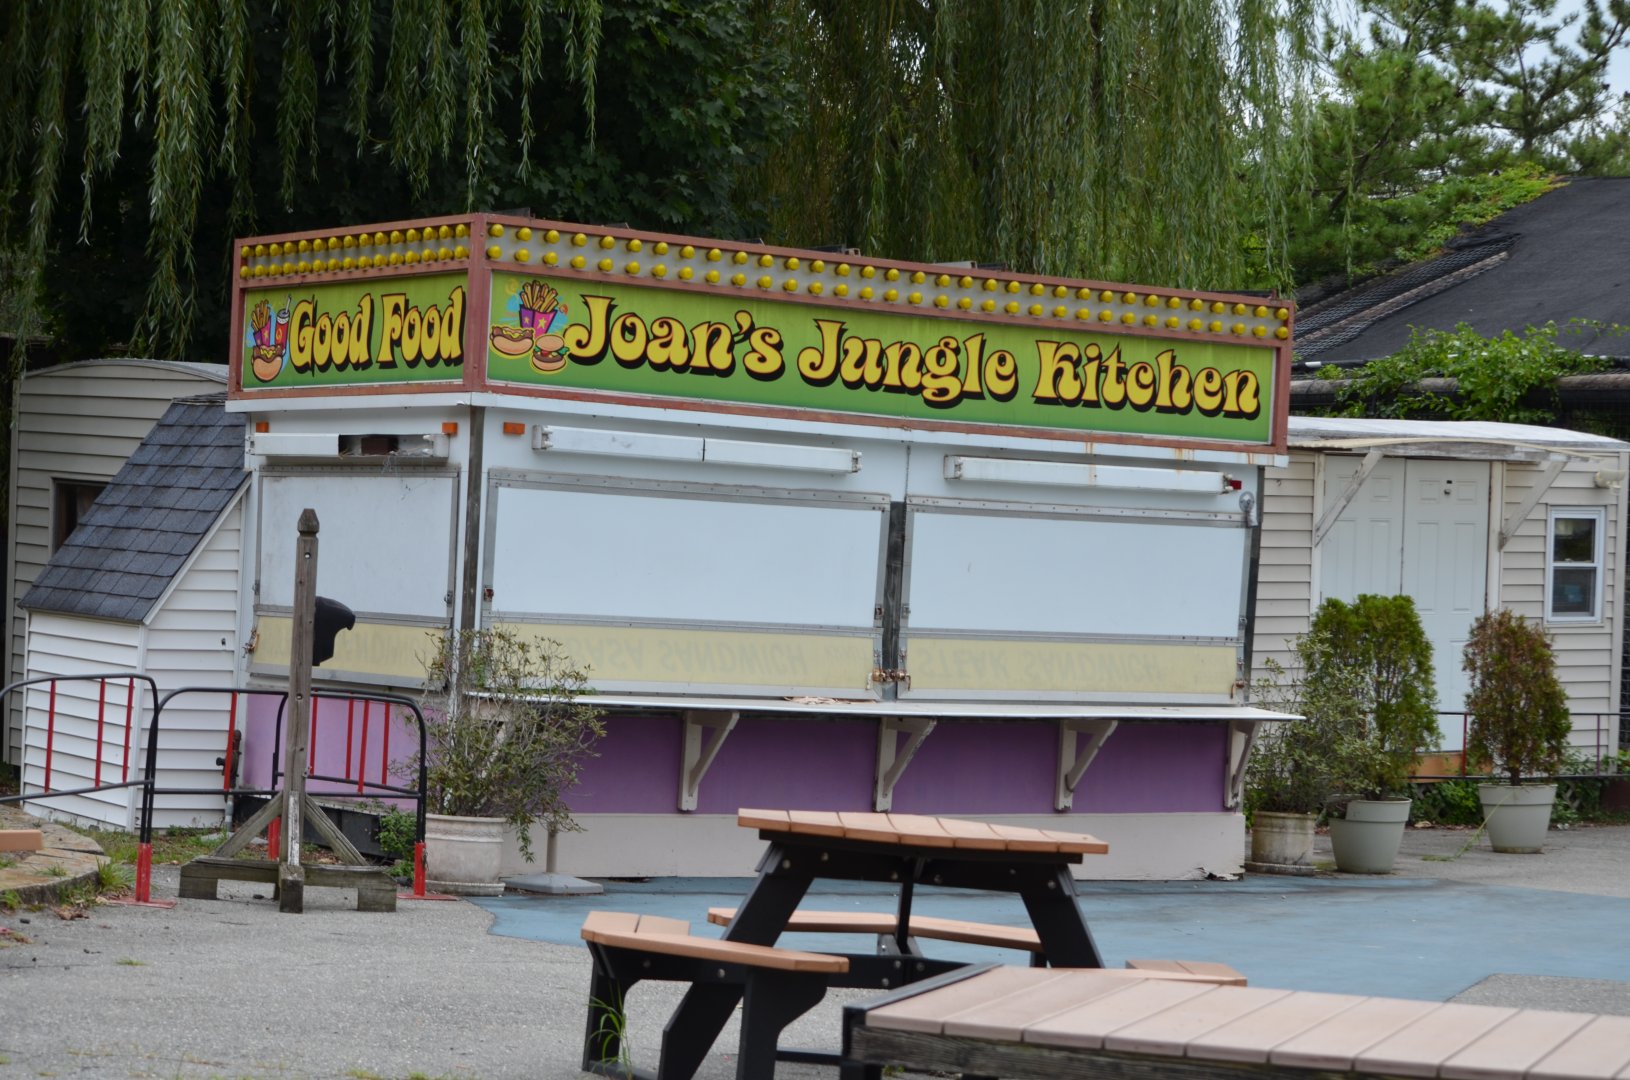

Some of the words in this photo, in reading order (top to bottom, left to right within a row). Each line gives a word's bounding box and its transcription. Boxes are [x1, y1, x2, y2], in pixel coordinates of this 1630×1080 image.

[289, 292, 373, 376] Good
[375, 285, 466, 370] Food
[563, 294, 785, 382] Joan's
[797, 318, 1018, 409] Jungle
[1031, 340, 1260, 420] Kitchen
